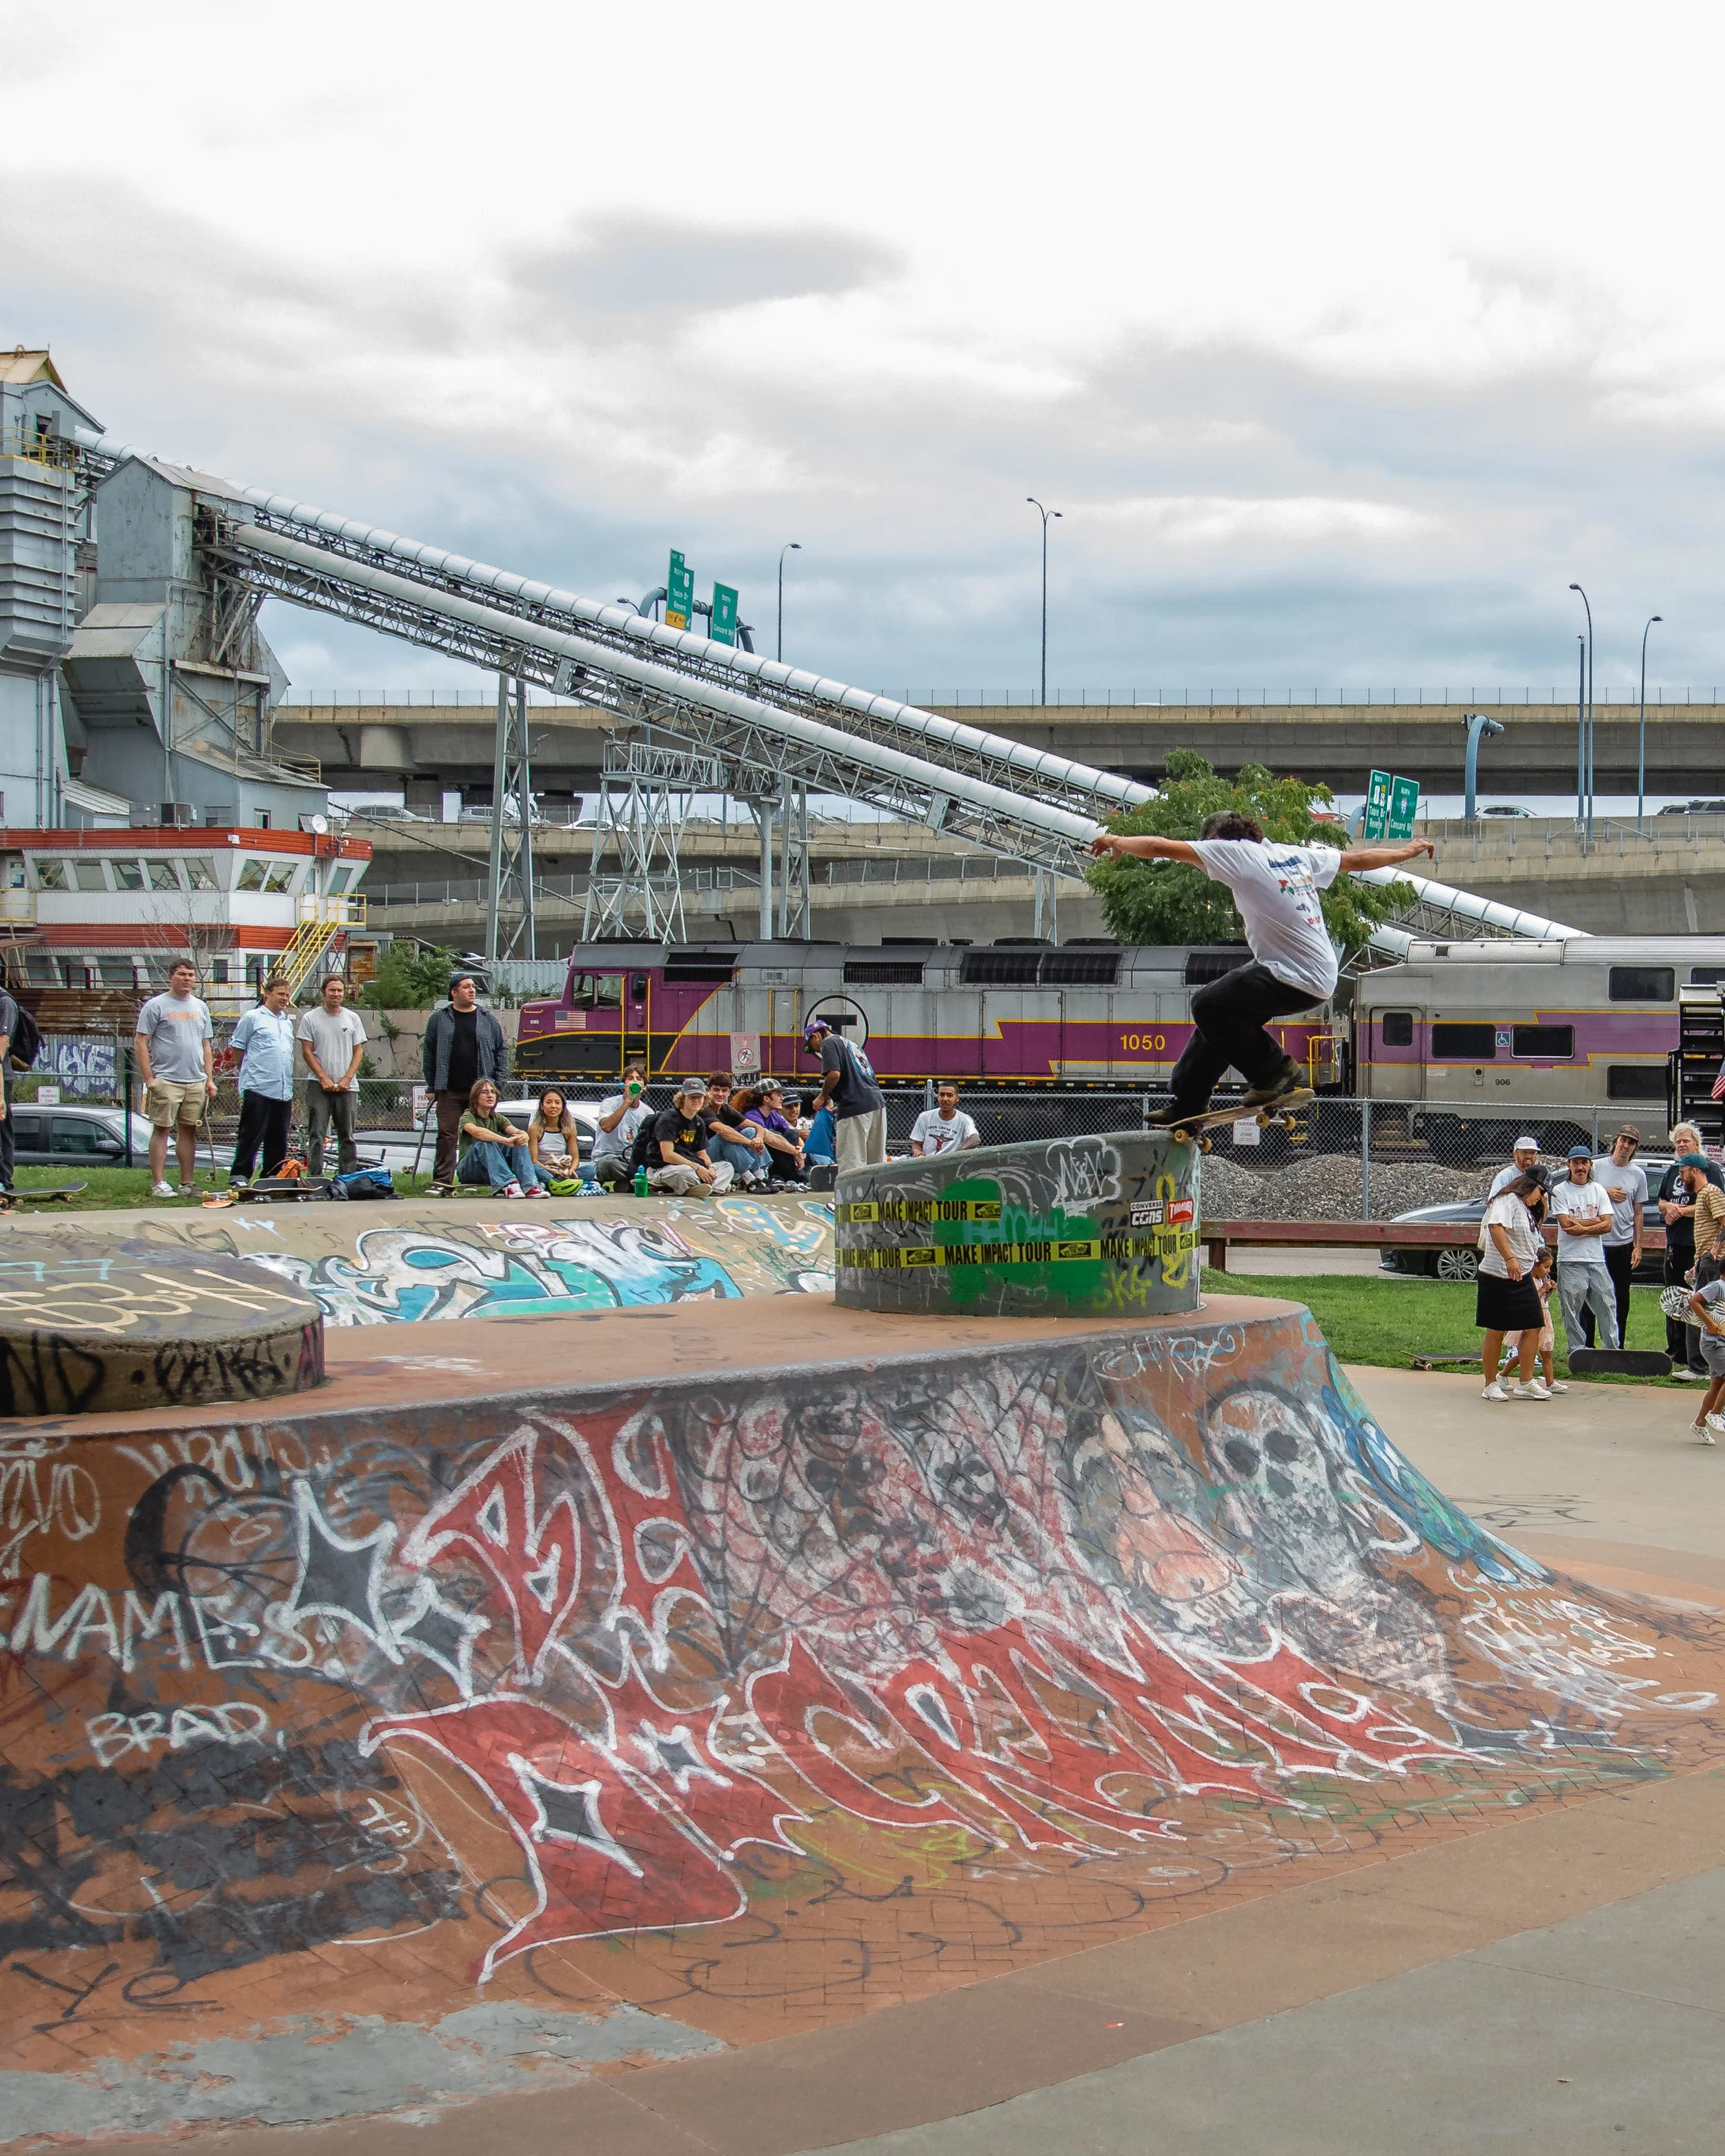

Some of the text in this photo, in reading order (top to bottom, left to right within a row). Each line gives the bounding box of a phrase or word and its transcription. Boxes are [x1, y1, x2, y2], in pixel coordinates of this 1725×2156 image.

[1391, 818, 1406, 831] Concord
[1120, 1035, 1165, 1051] 1050
[878, 1200, 967, 1221] MAKE IMPACT TOUR
[1132, 1201, 1162, 1209] CONVERSE
[1132, 1210, 1163, 1225] CONS
[877, 1247, 900, 1267] TOUR
[945, 1244, 978, 1265] MAKE
[980, 1243, 1014, 1264] IMPACT
[1017, 1241, 1051, 1263] TOUR
[1101, 1238, 1130, 1259] MAKE
[1132, 1236, 1155, 1257] IMPACT
[1157, 1234, 1177, 1254] TOUR
[86, 1701, 269, 1768] BRAD
